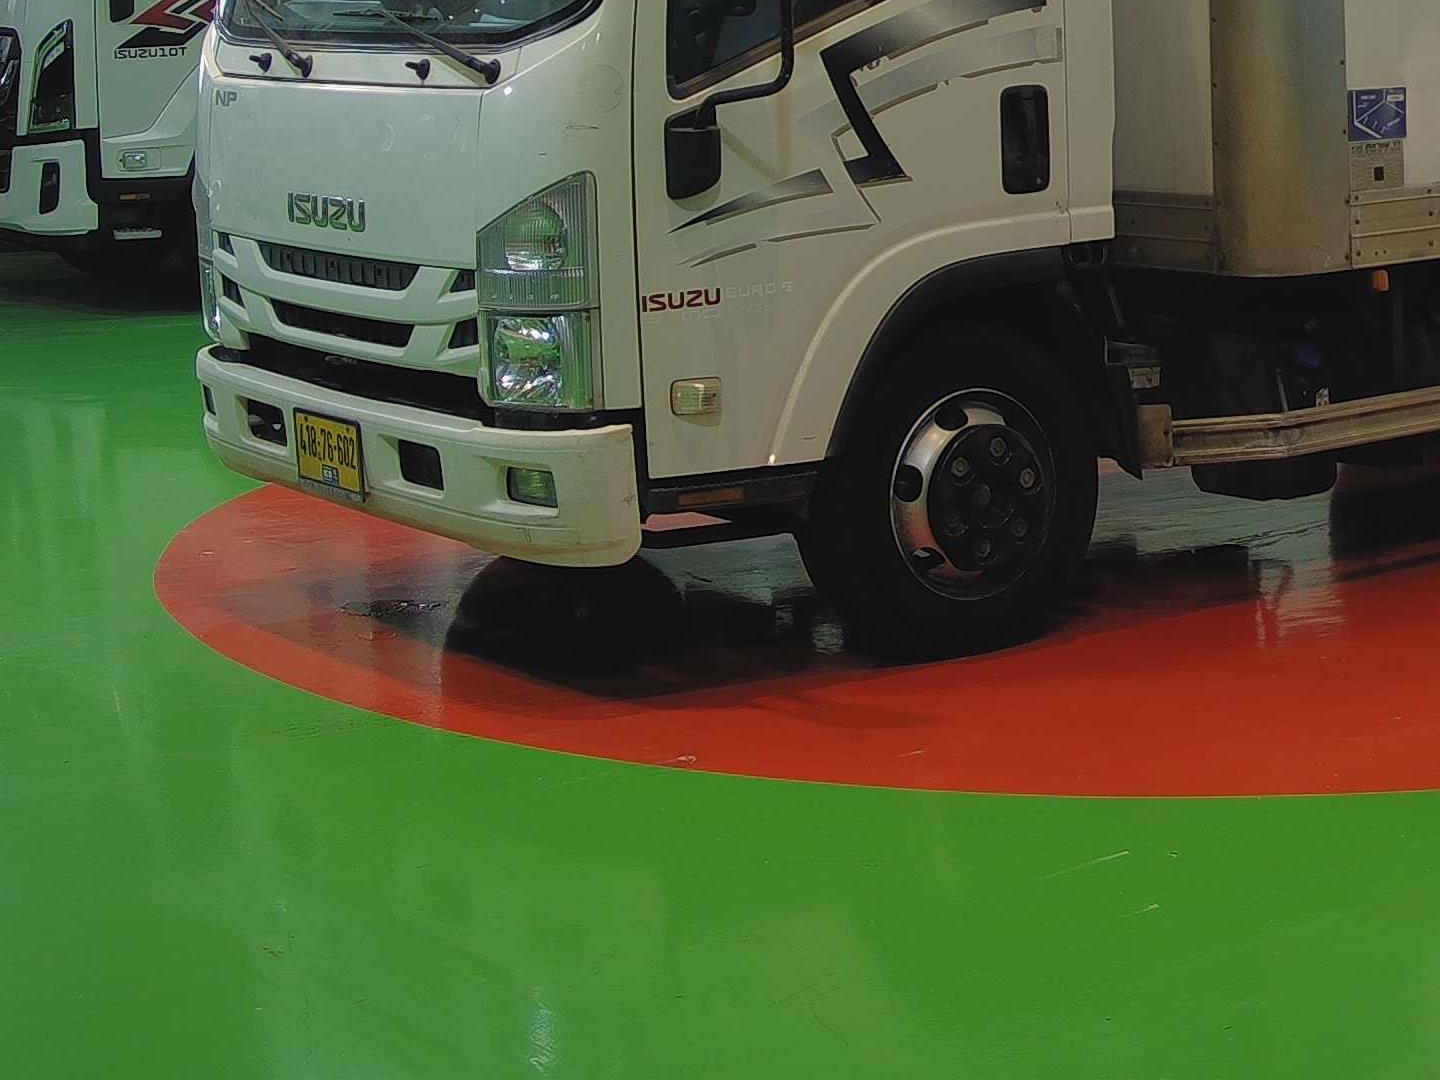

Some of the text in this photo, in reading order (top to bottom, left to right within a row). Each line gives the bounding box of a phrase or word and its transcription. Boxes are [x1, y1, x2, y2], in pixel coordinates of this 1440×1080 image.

[215, 90, 238, 107] NP
[287, 191, 366, 233] ISUZU
[641, 287, 721, 313] ISUZU
